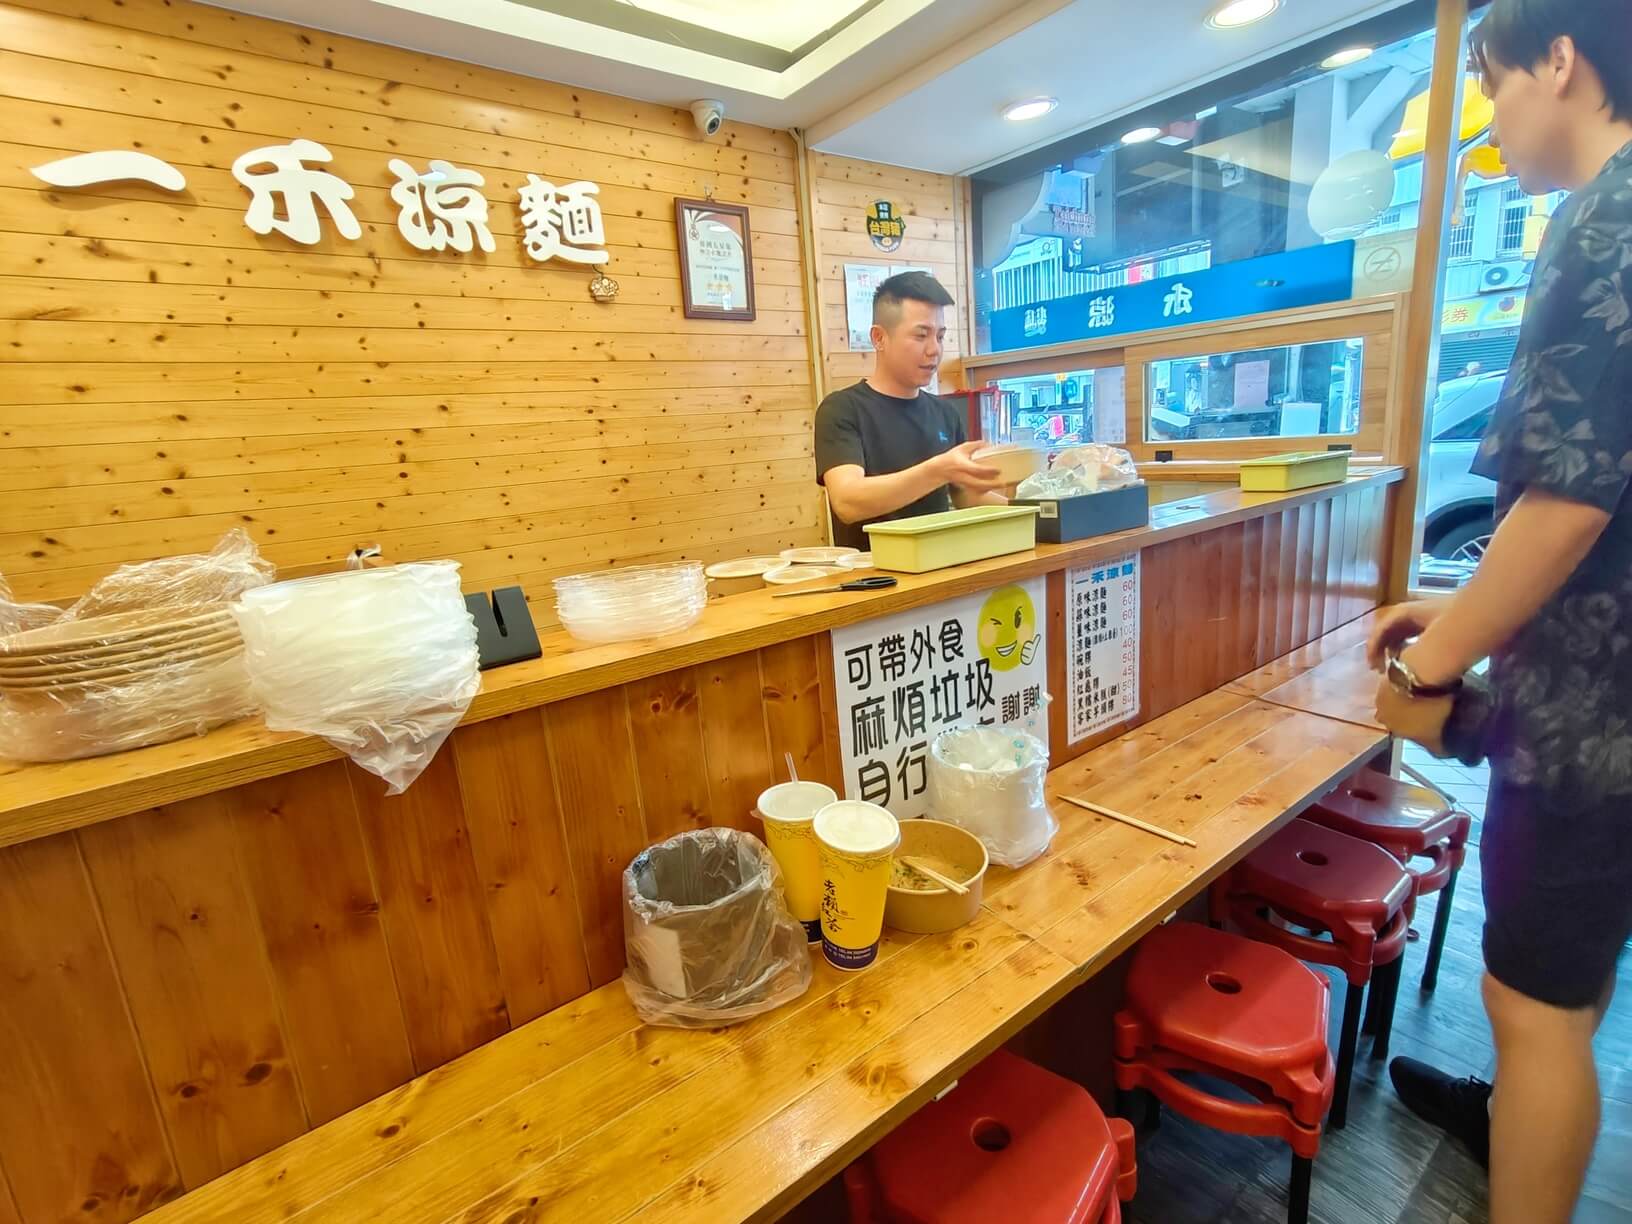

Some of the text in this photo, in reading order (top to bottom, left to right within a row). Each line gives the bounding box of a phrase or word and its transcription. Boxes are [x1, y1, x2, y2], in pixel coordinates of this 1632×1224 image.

[844, 618, 965, 691] 可帶外食
[850, 657, 996, 758] 麻煩垃圾
